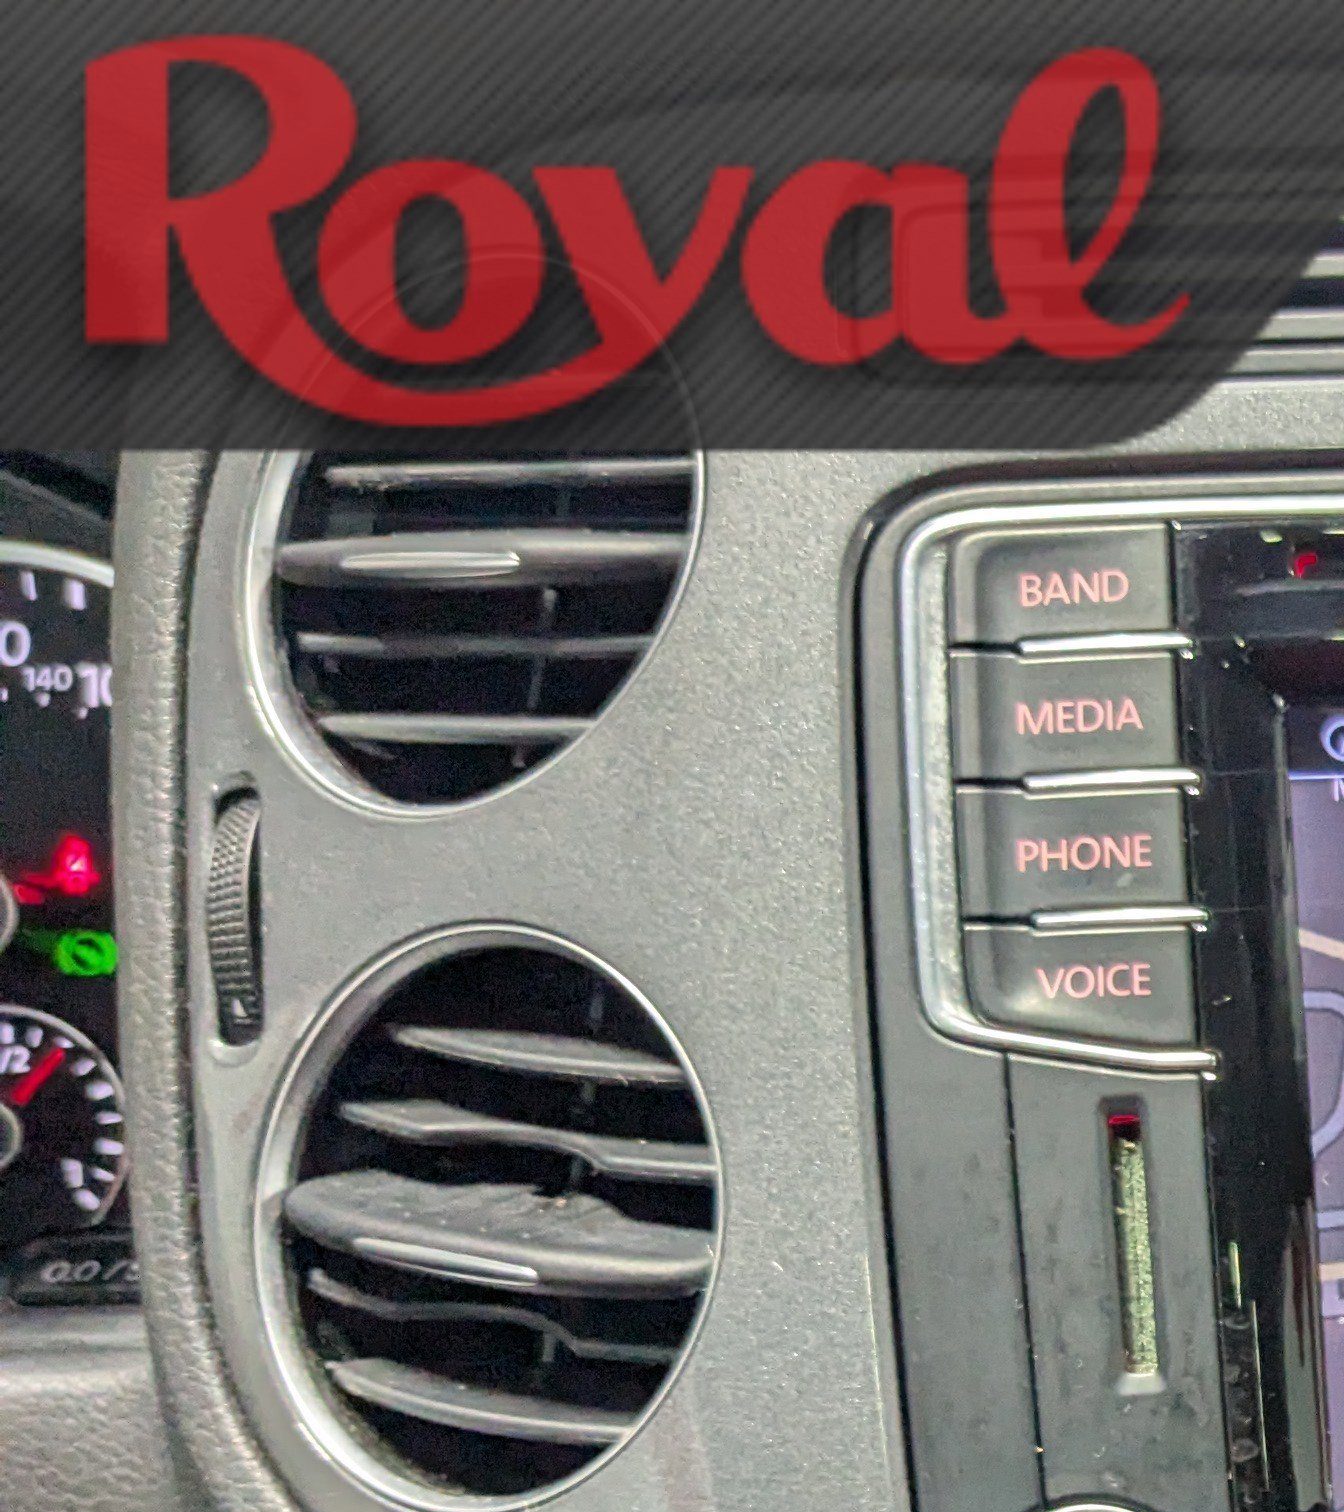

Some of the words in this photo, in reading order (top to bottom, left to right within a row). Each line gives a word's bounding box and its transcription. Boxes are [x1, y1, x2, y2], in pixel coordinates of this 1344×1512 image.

[1018, 569, 1129, 607] BAND
[22, 664, 73, 692] 140
[1016, 698, 1143, 735] MEDIA
[1017, 834, 1152, 872] PHONE
[1037, 962, 1152, 998] VOICE
